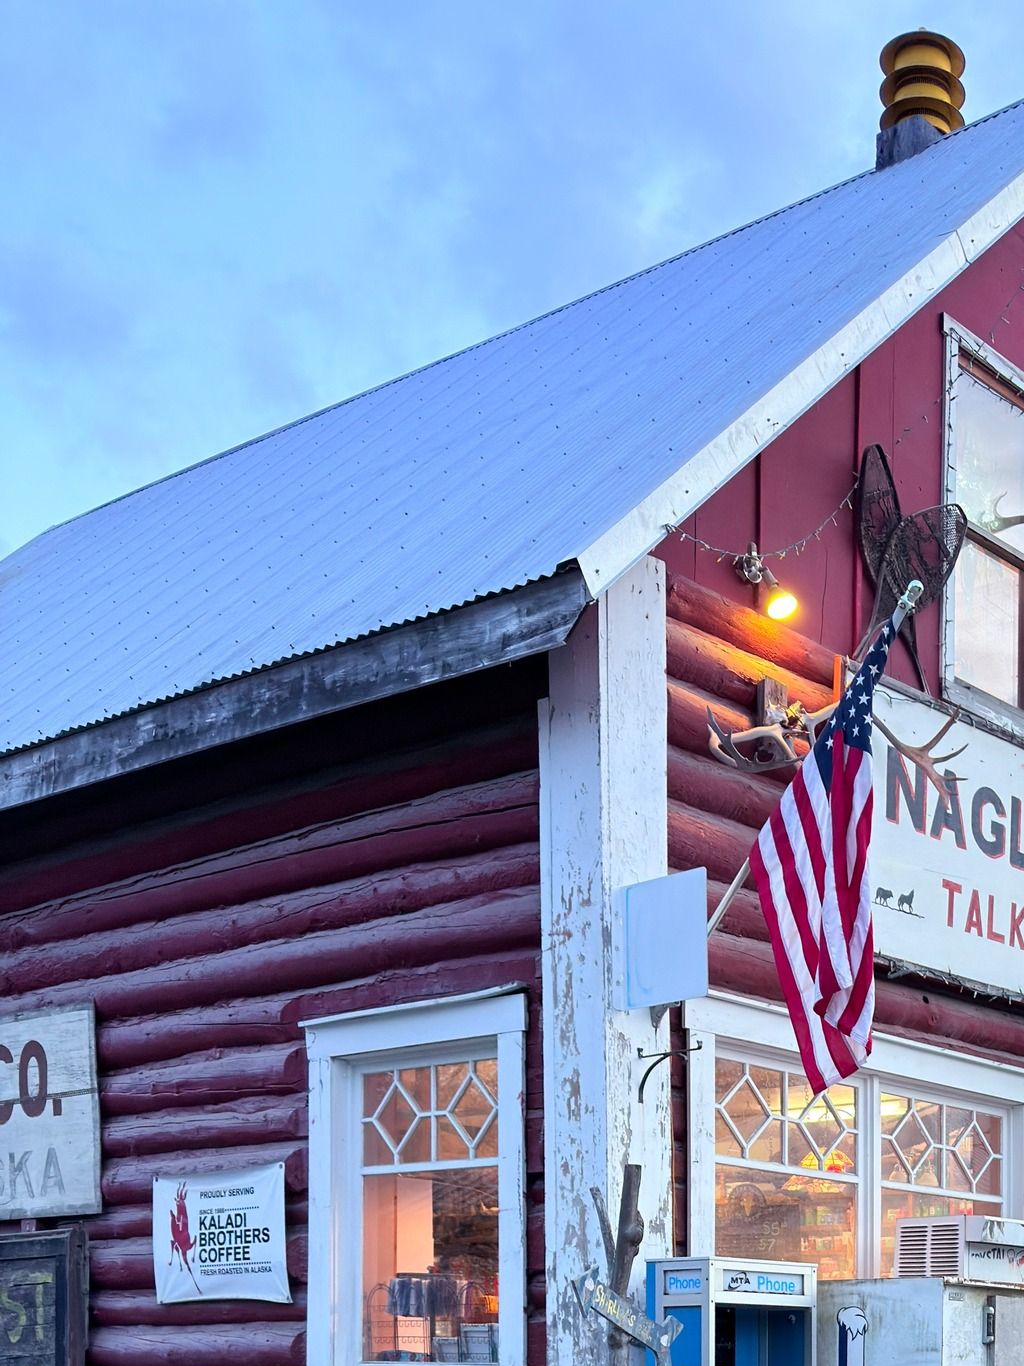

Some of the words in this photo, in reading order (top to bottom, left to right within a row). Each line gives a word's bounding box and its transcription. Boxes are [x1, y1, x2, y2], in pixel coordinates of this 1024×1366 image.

[200, 1190, 227, 1200] PROUDLY
[229, 1187, 255, 1197] SERVING
[199, 1212, 247, 1231] KALADI
[199, 1227, 270, 1247] BROTHERS
[199, 1245, 251, 1264] COFFEE
[200, 1268, 217, 1276] FRESH
[218, 1267, 243, 1275] ROASTED
[250, 1266, 272, 1274] ALASKA
[669, 1276, 701, 1291] Phone
[730, 1276, 751, 1285] MTA
[757, 1275, 796, 1292] Phone
